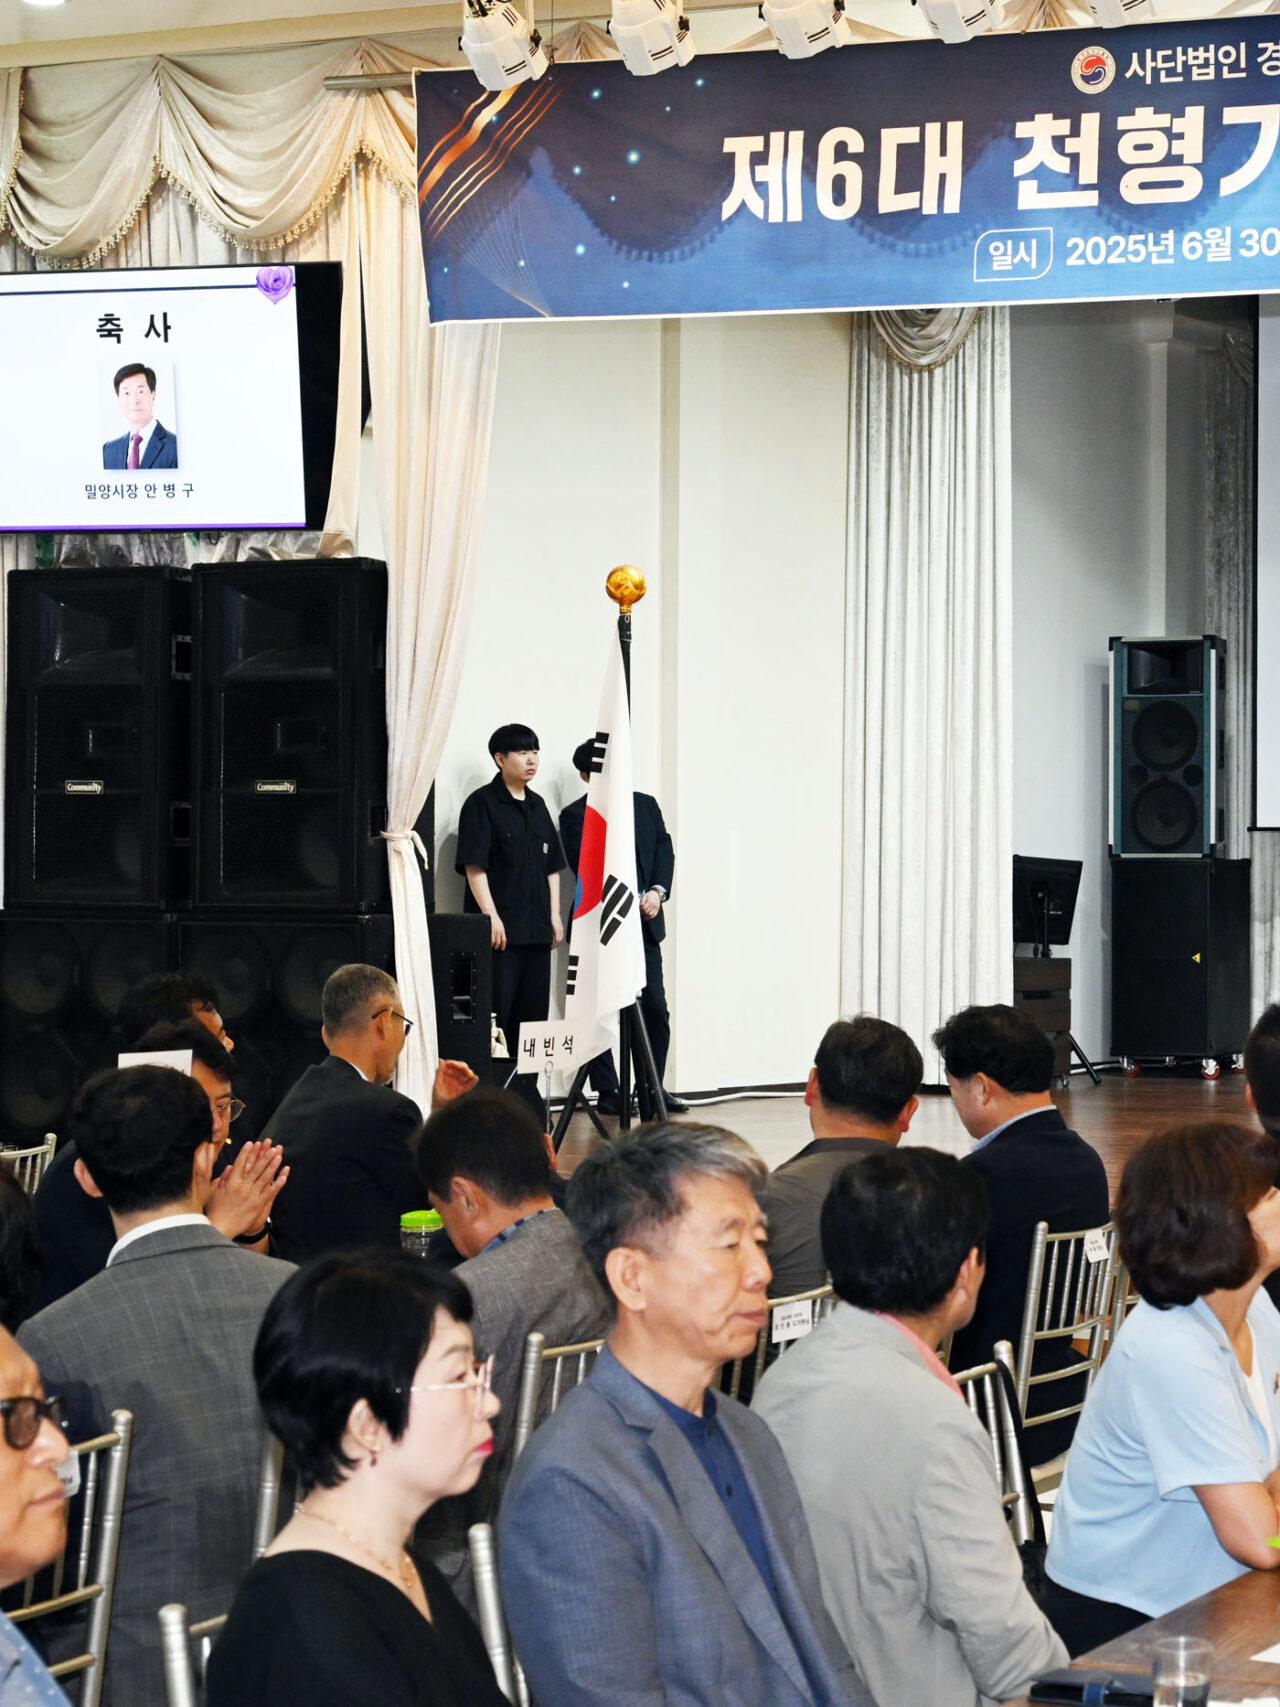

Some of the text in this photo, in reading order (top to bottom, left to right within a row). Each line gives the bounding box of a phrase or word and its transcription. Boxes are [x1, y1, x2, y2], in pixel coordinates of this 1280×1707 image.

[1124, 43, 1247, 84] 사단법인
[721, 121, 965, 223] 제6대
[988, 239, 1038, 271] 일시
[1065, 230, 1175, 271] 2025년
[1181, 223, 1232, 265] 6월
[96, 311, 172, 344] 축 사
[84, 483, 139, 500] 밀양시장
[67, 782, 102, 794] Community
[257, 781, 294, 793] Community
